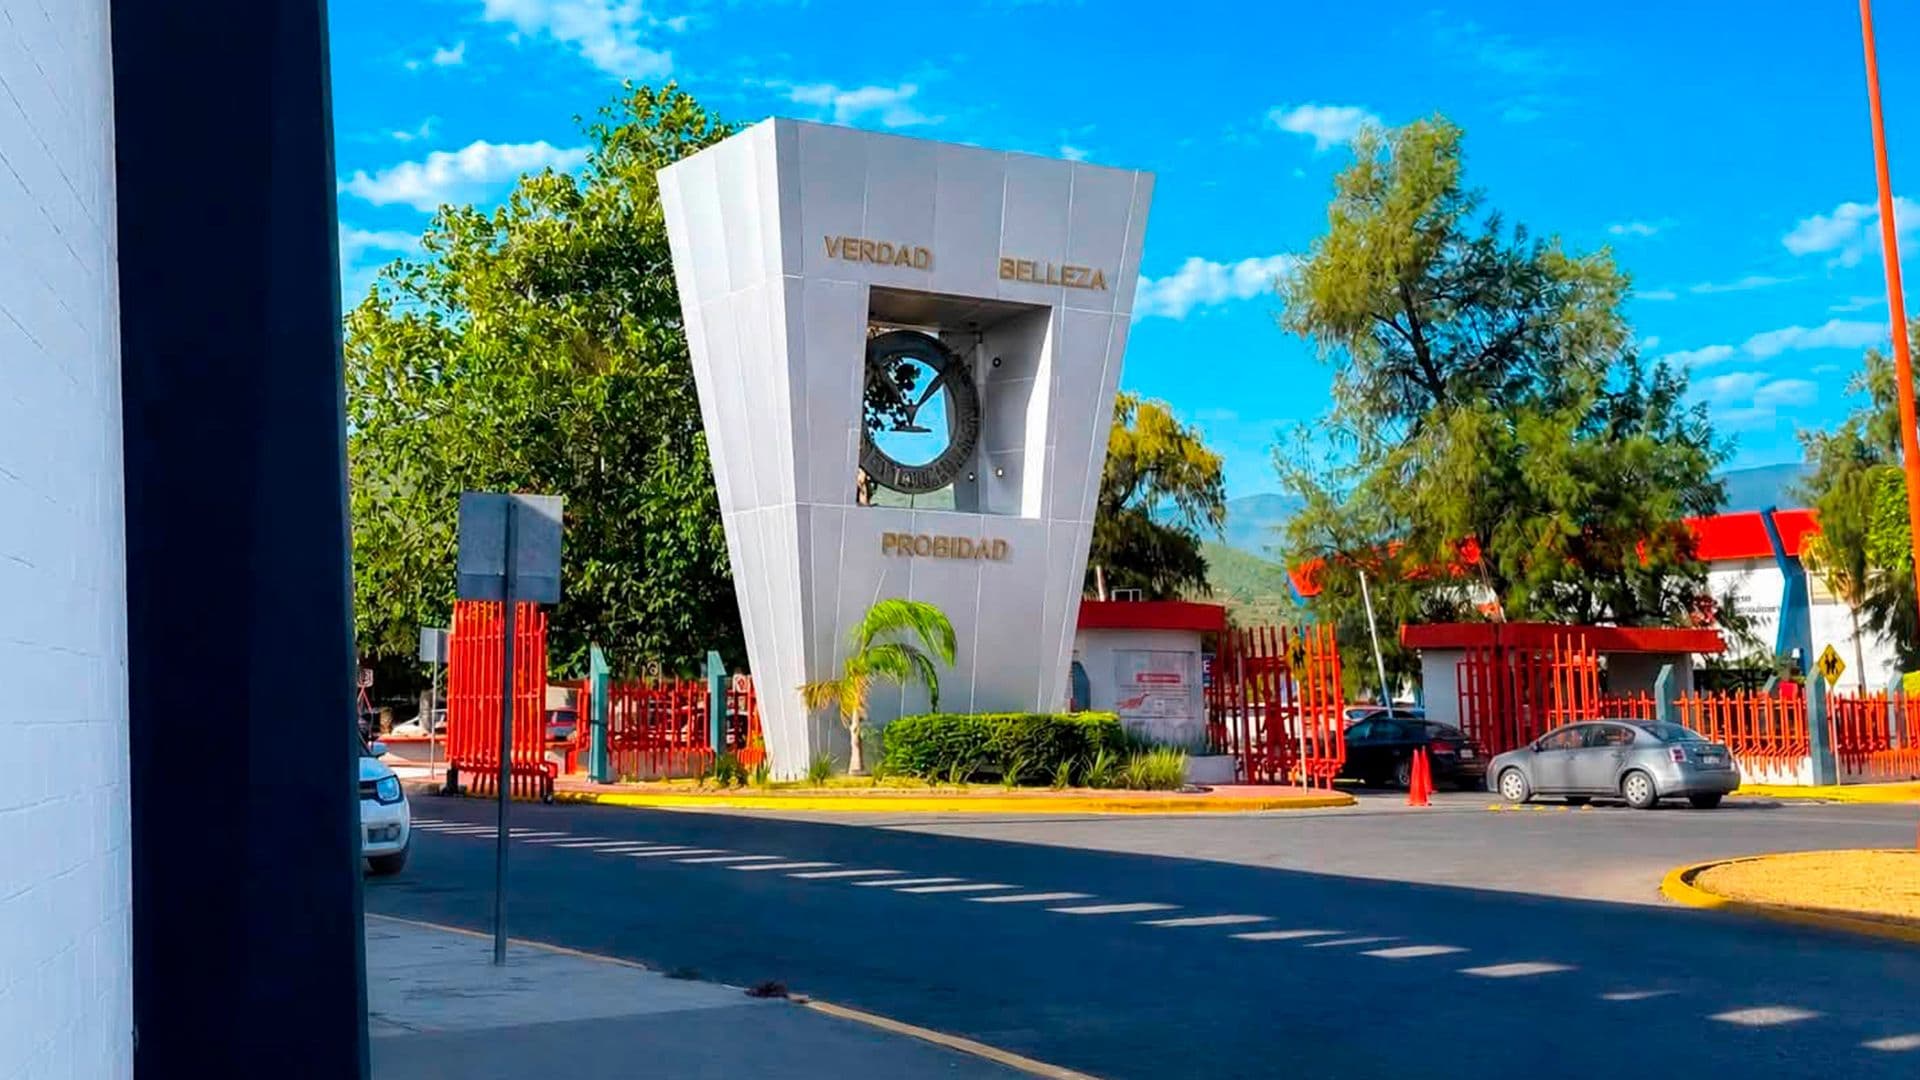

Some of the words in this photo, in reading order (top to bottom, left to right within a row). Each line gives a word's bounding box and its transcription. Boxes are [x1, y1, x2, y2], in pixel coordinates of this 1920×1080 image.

[824, 235, 932, 269] VERDAD
[1000, 256, 1107, 290] BELLEZA
[882, 532, 1010, 561] PROBIDAD
